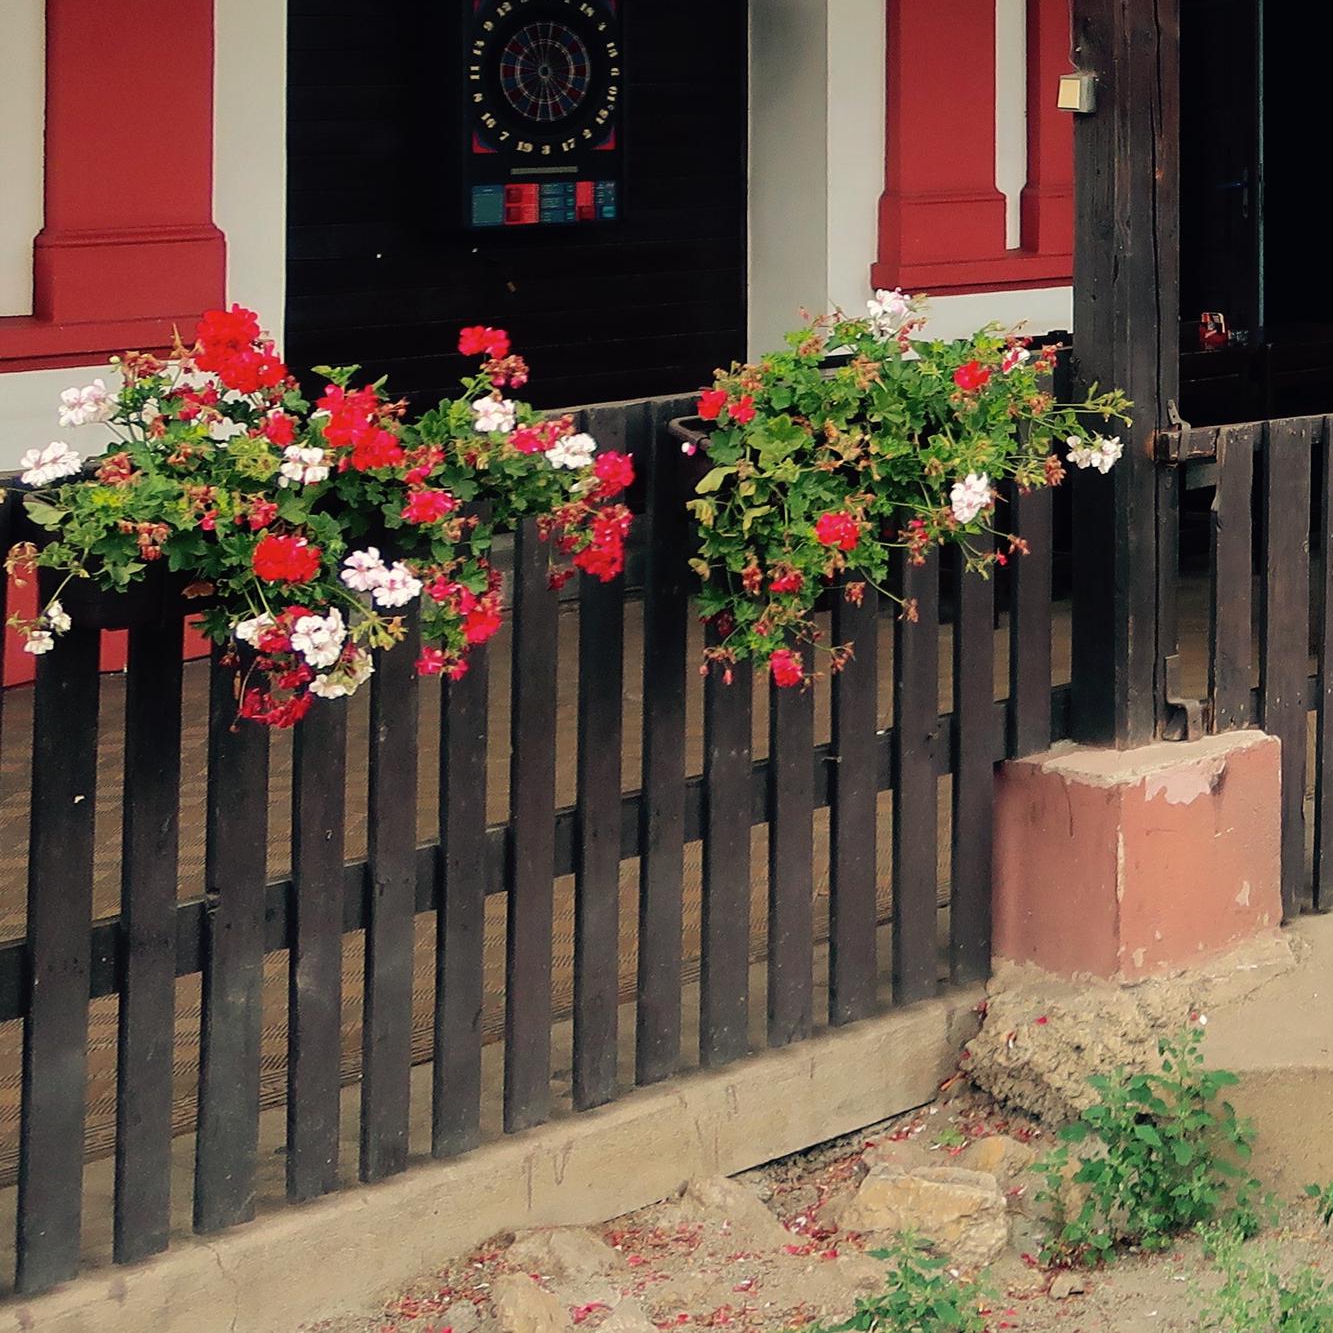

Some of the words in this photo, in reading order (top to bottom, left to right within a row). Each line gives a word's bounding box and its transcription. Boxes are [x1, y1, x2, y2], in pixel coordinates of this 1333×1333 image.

[469, 66, 480, 80] 11
[499, 130, 510, 141] 7
[516, 141, 534, 153] 19
[541, 144, 551, 155] 3
[562, 137, 576, 152] 17
